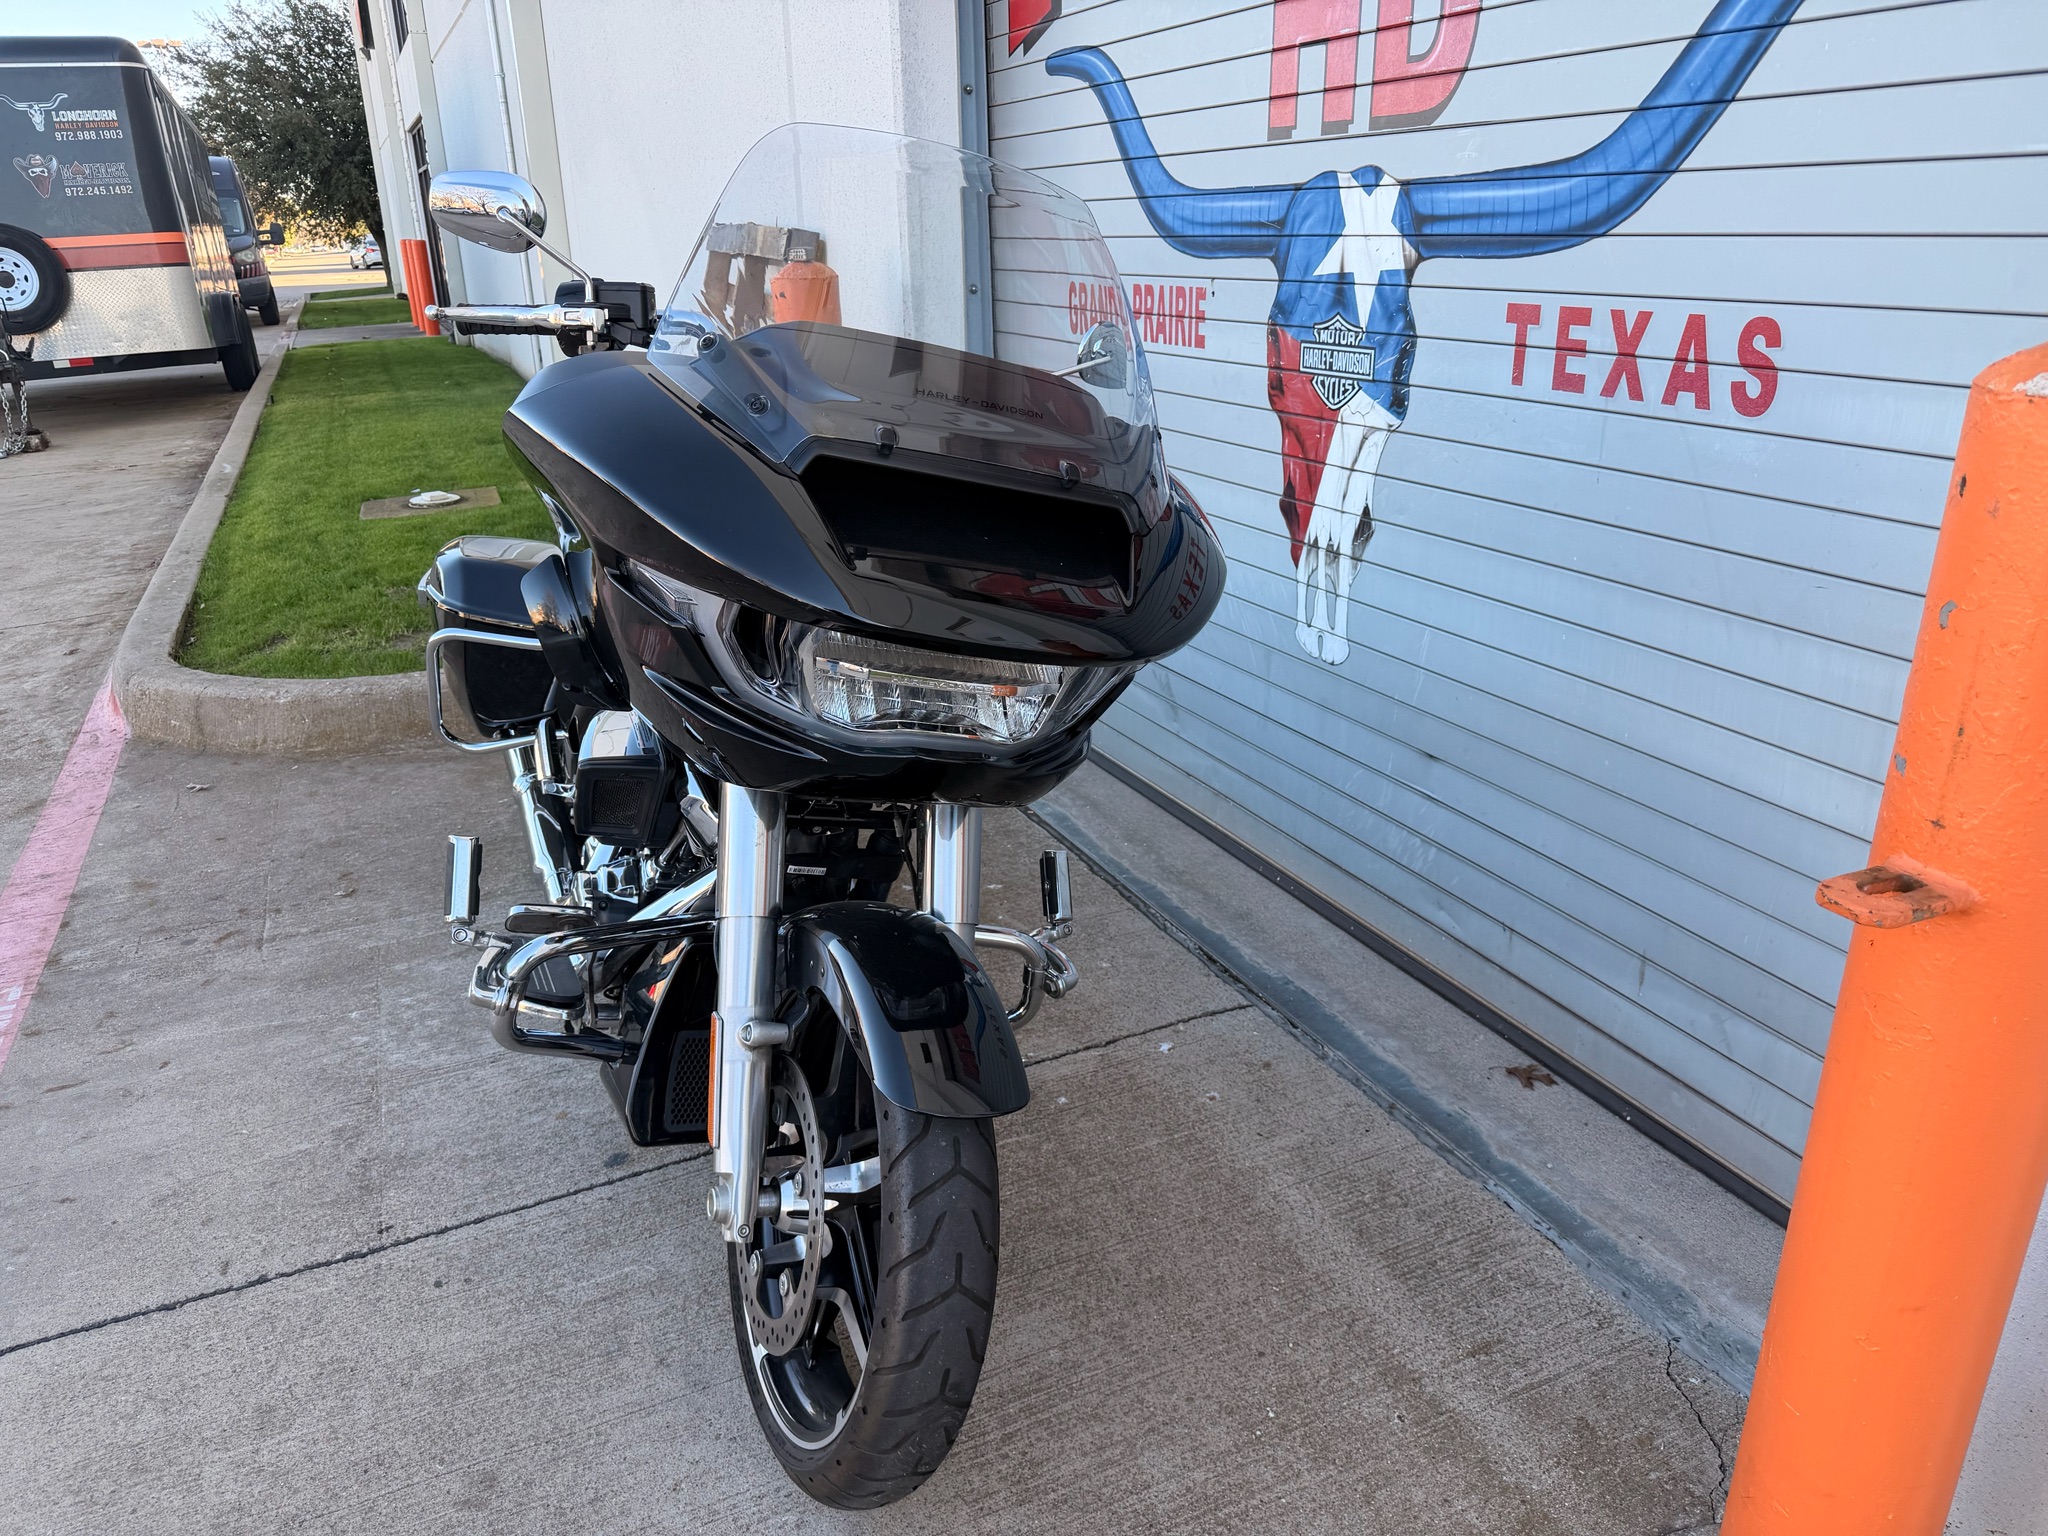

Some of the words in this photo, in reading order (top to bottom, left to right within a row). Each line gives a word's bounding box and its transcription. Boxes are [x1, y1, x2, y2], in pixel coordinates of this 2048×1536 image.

[51, 109, 117, 121] LONGHORN
[54, 129, 123, 141] 972.988.1903
[64, 185, 134, 197] 972.245.1492
[1132, 283, 1207, 349] PRAIRIE
[1319, 329, 1356, 344] MOTOR
[1303, 347, 1371, 375] HARLEY-DAVIDSON
[1505, 302, 1782, 418] TEXAS
[1317, 377, 1353, 403] CYCLES
